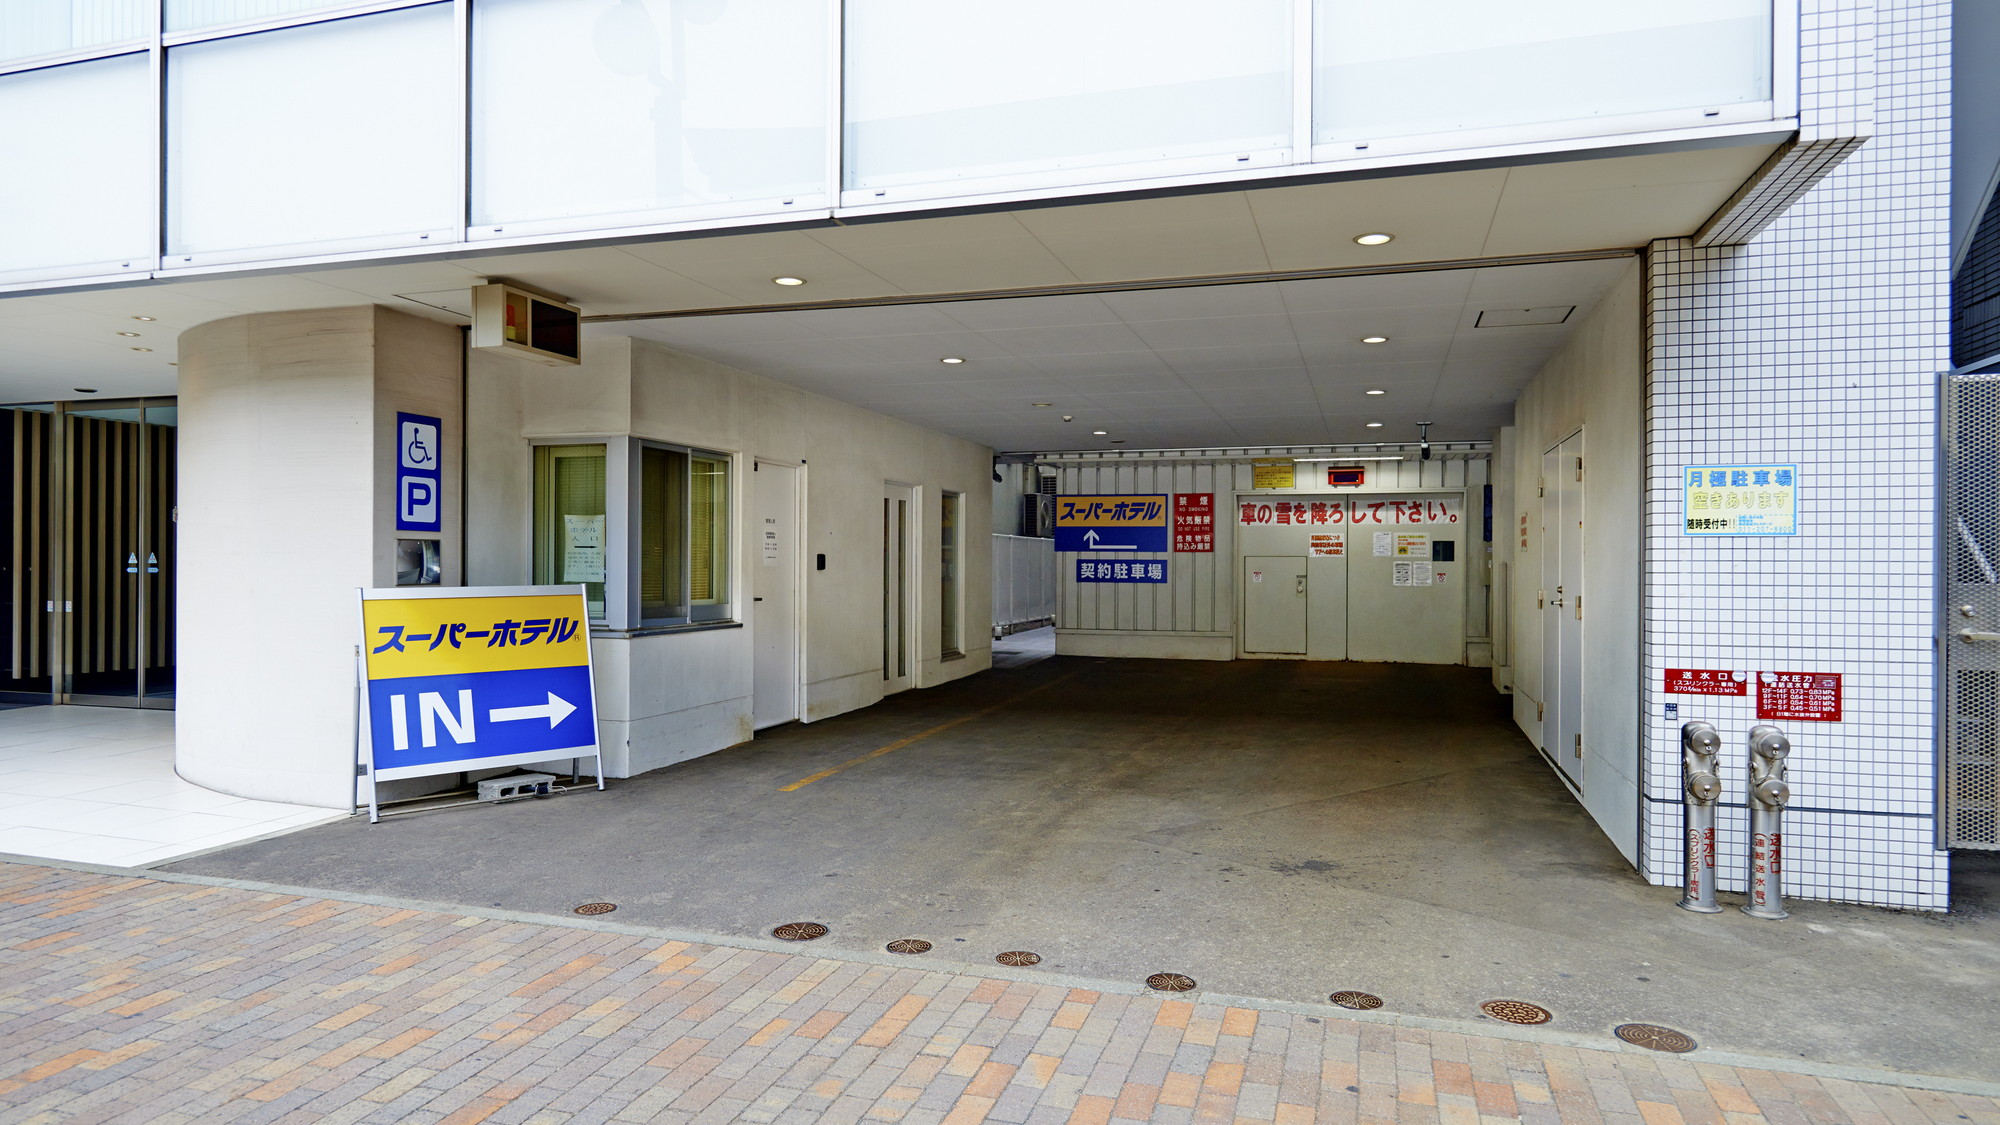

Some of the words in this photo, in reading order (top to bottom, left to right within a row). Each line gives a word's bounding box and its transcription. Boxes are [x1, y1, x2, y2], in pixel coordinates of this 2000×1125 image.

[1688, 469, 1793, 488] 月極駐車場
[407, 482, 432, 516] P
[1179, 496, 1209, 506] 禁煙
[1692, 490, 1789, 510] 空きあります
[1059, 501, 1162, 521] スーパーホテル
[1177, 515, 1211, 525] 火気厳禁
[1240, 500, 1458, 526] 車の雪を降ろして下さい。
[1176, 535, 1211, 543] 危険物品
[1176, 542, 1211, 551] 持込み厳禁
[1080, 562, 1163, 580] 契約駐車場
[1682, 671, 1728, 680] 送水口
[390, 688, 477, 751] IN
